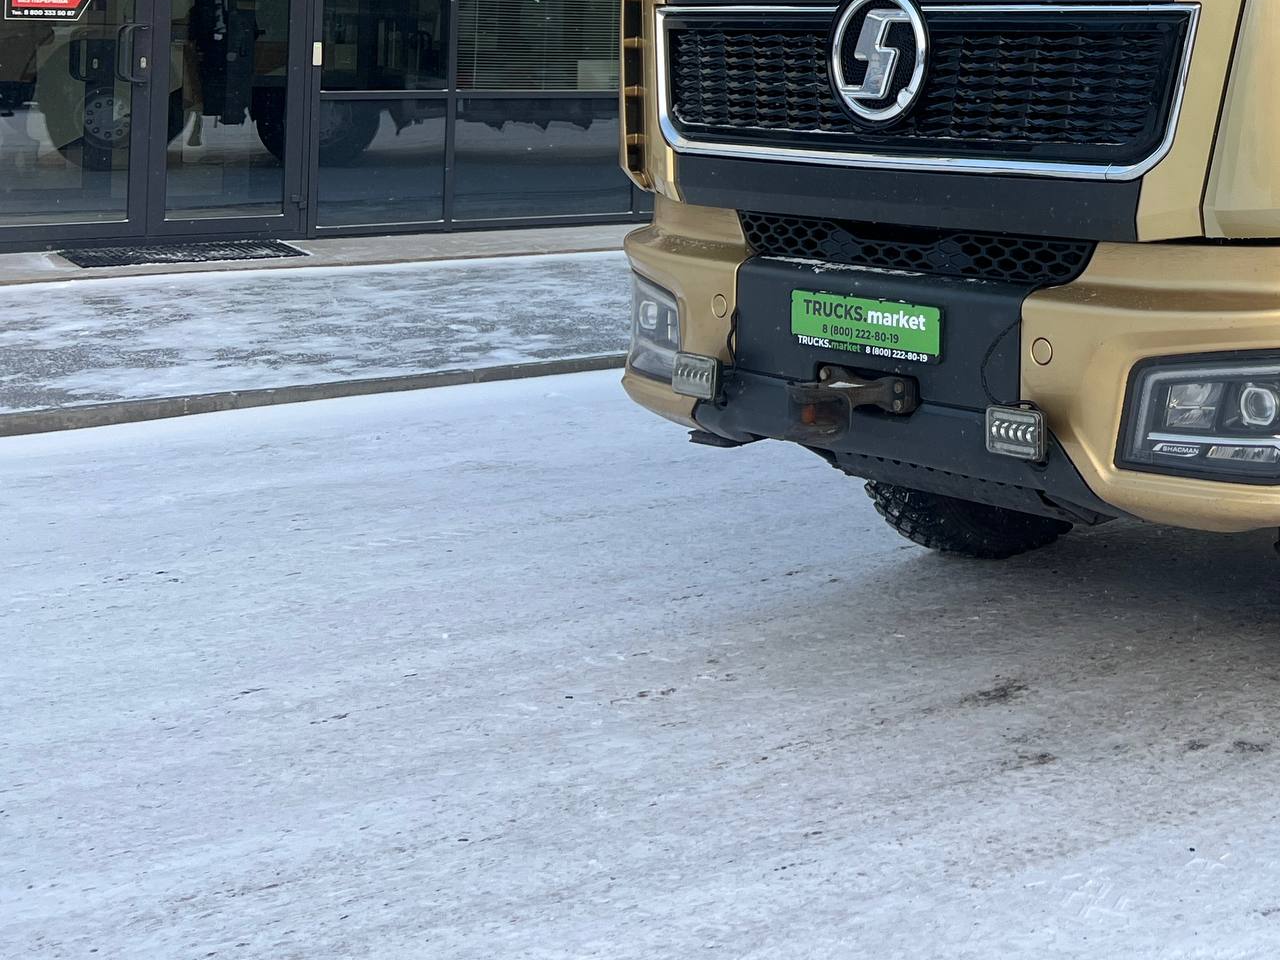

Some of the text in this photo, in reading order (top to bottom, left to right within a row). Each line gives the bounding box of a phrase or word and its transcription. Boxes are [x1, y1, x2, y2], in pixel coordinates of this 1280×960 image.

[803, 299, 926, 331] TRUCKS.market
[822, 324, 900, 344] 8 (800) 222-80-19
[797, 335, 928, 363] TRUCKS.market 8 (800) 222-80-19
[1162, 445, 1200, 454] SHACMAN
